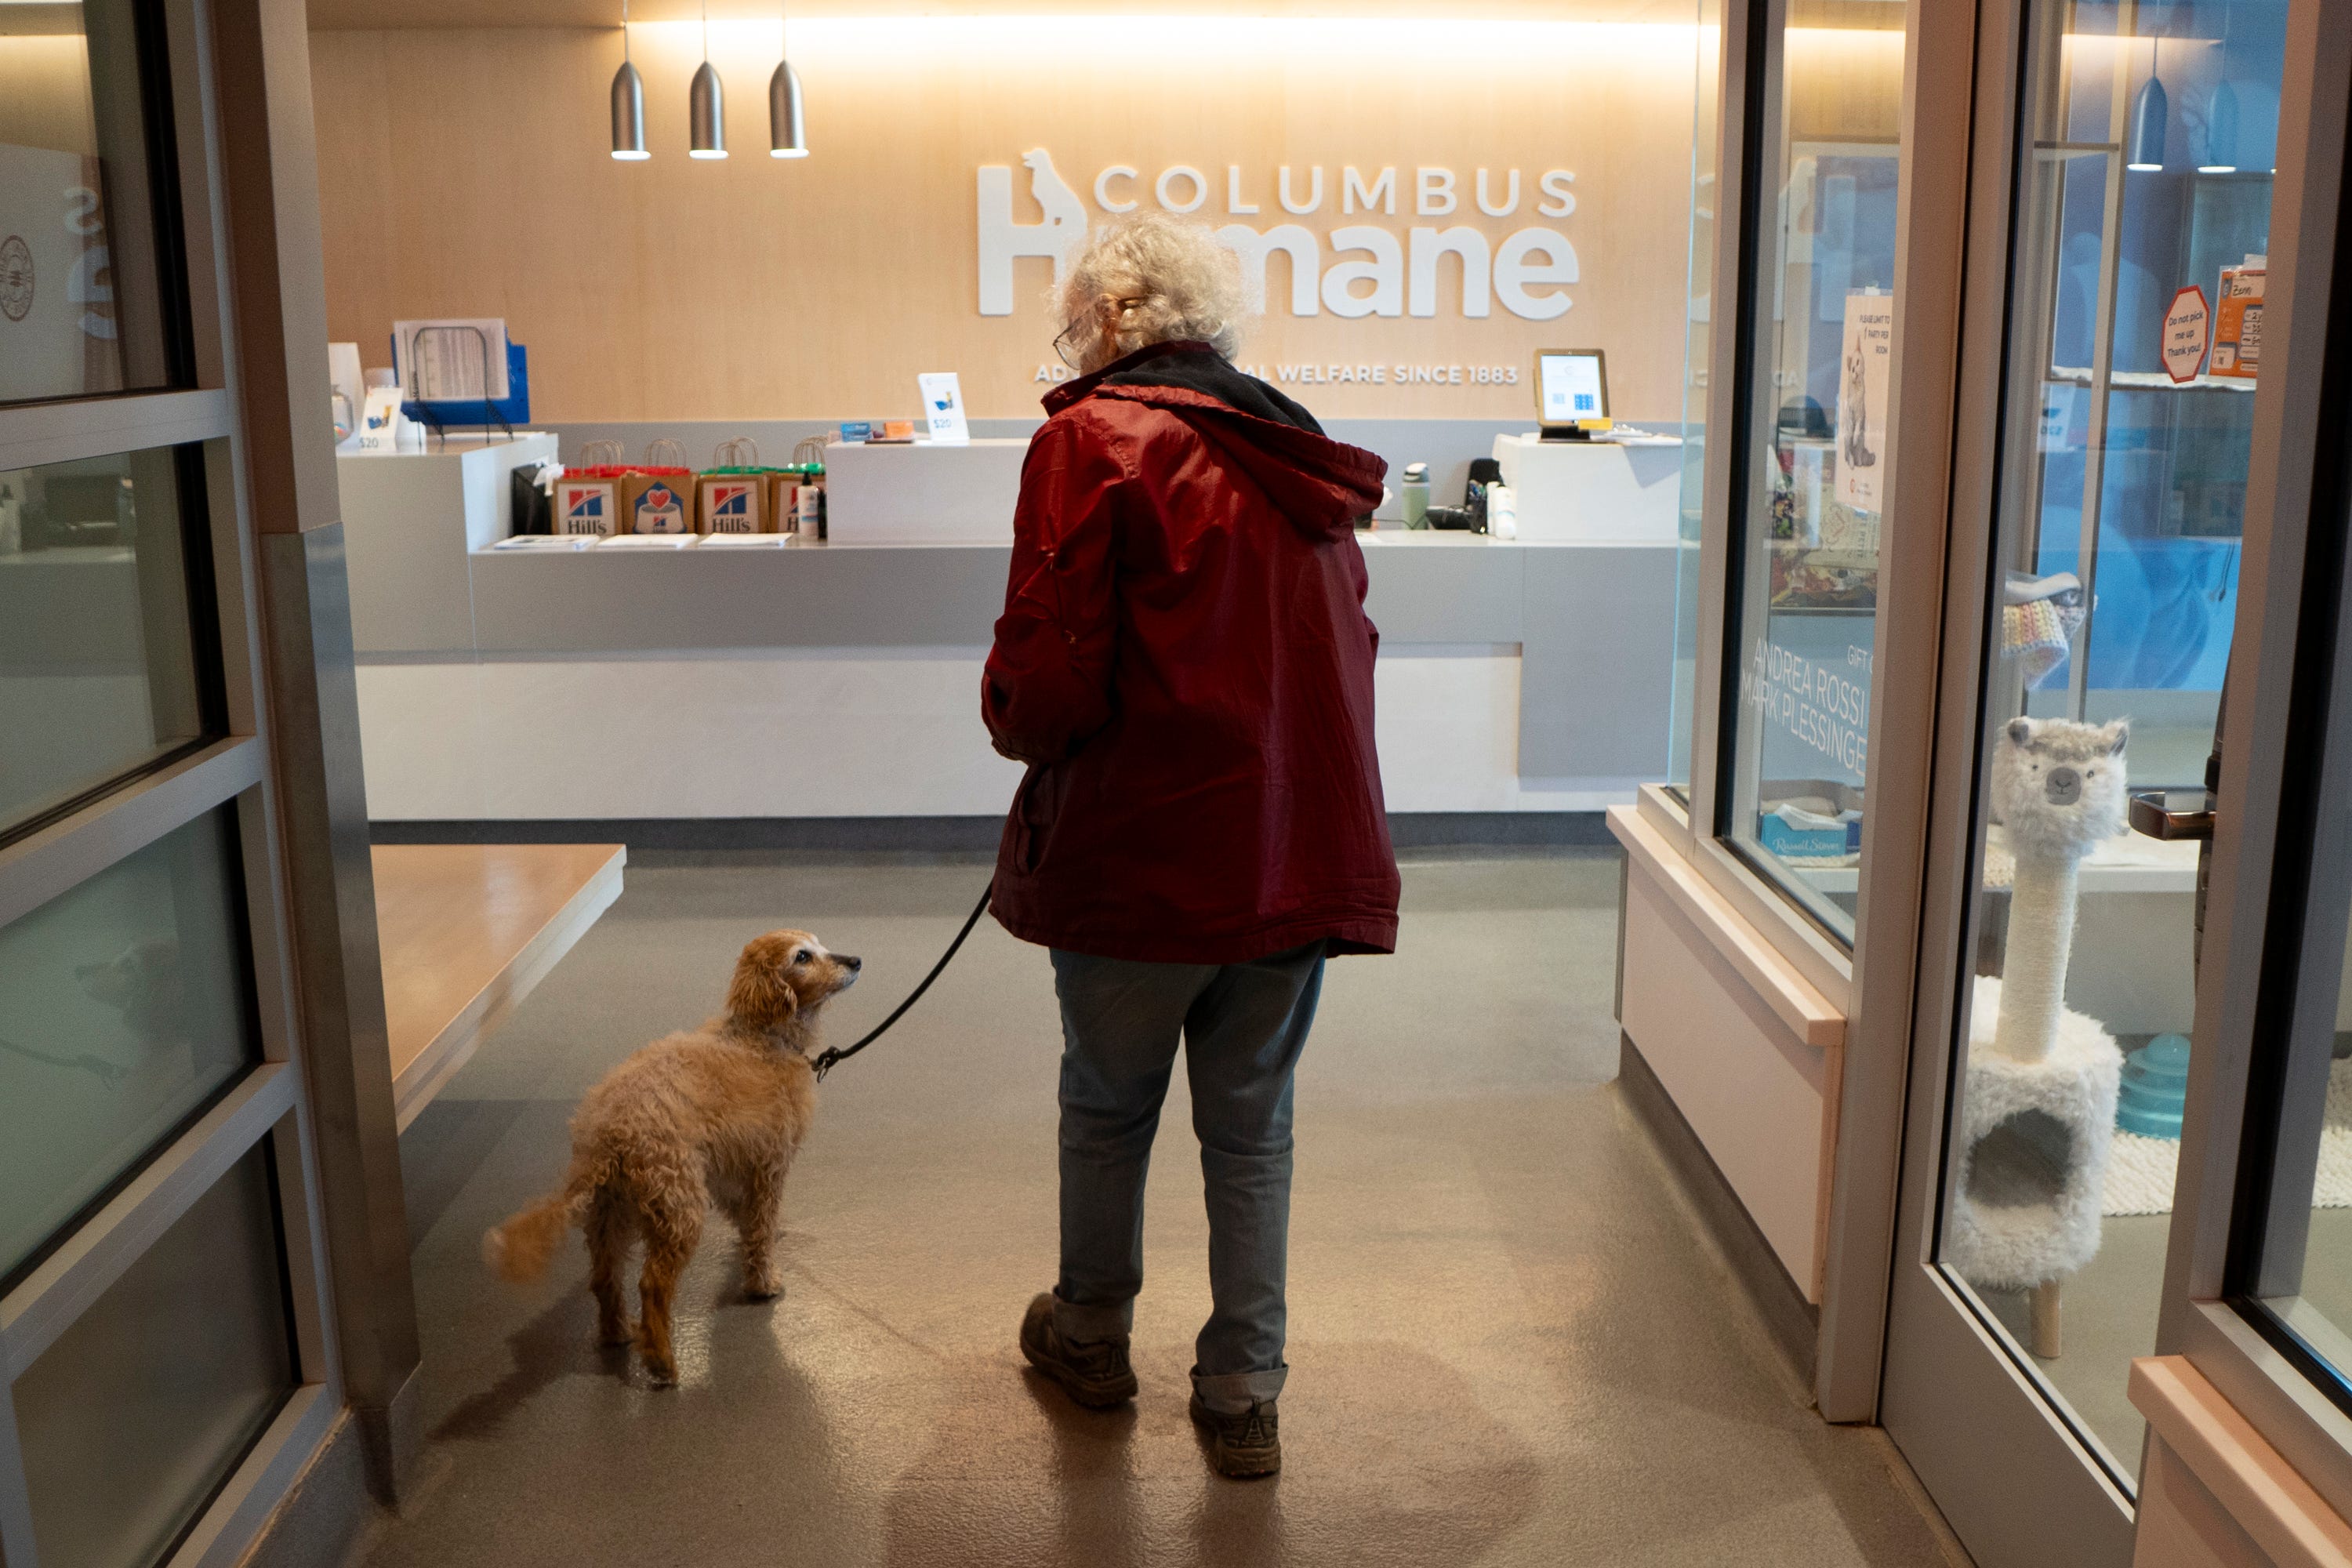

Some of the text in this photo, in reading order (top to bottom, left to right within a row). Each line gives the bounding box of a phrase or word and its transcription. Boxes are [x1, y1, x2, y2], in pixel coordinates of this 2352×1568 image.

[1094, 165, 1577, 219] COLUMBUS
[978, 149, 1580, 320] Hmane
[1860, 314, 1873, 324] PLEASE
[1884, 315, 1890, 324] TO
[2169, 310, 2204, 326] Do not pick
[2175, 330, 2194, 340] me up
[2167, 347, 2187, 358] Thank
[1276, 365, 1386, 383] WELFARE
[1394, 365, 1462, 385] SINCE
[1467, 365, 1519, 385] 1883
[359, 437, 379, 448] $20
[568, 520, 607, 534] Hill's
[713, 517, 750, 532] Hill's
[1847, 644, 1868, 670] GIFT
[1753, 637, 1864, 728] ANDREA ROSSI
[1741, 668, 1778, 722] MARK
